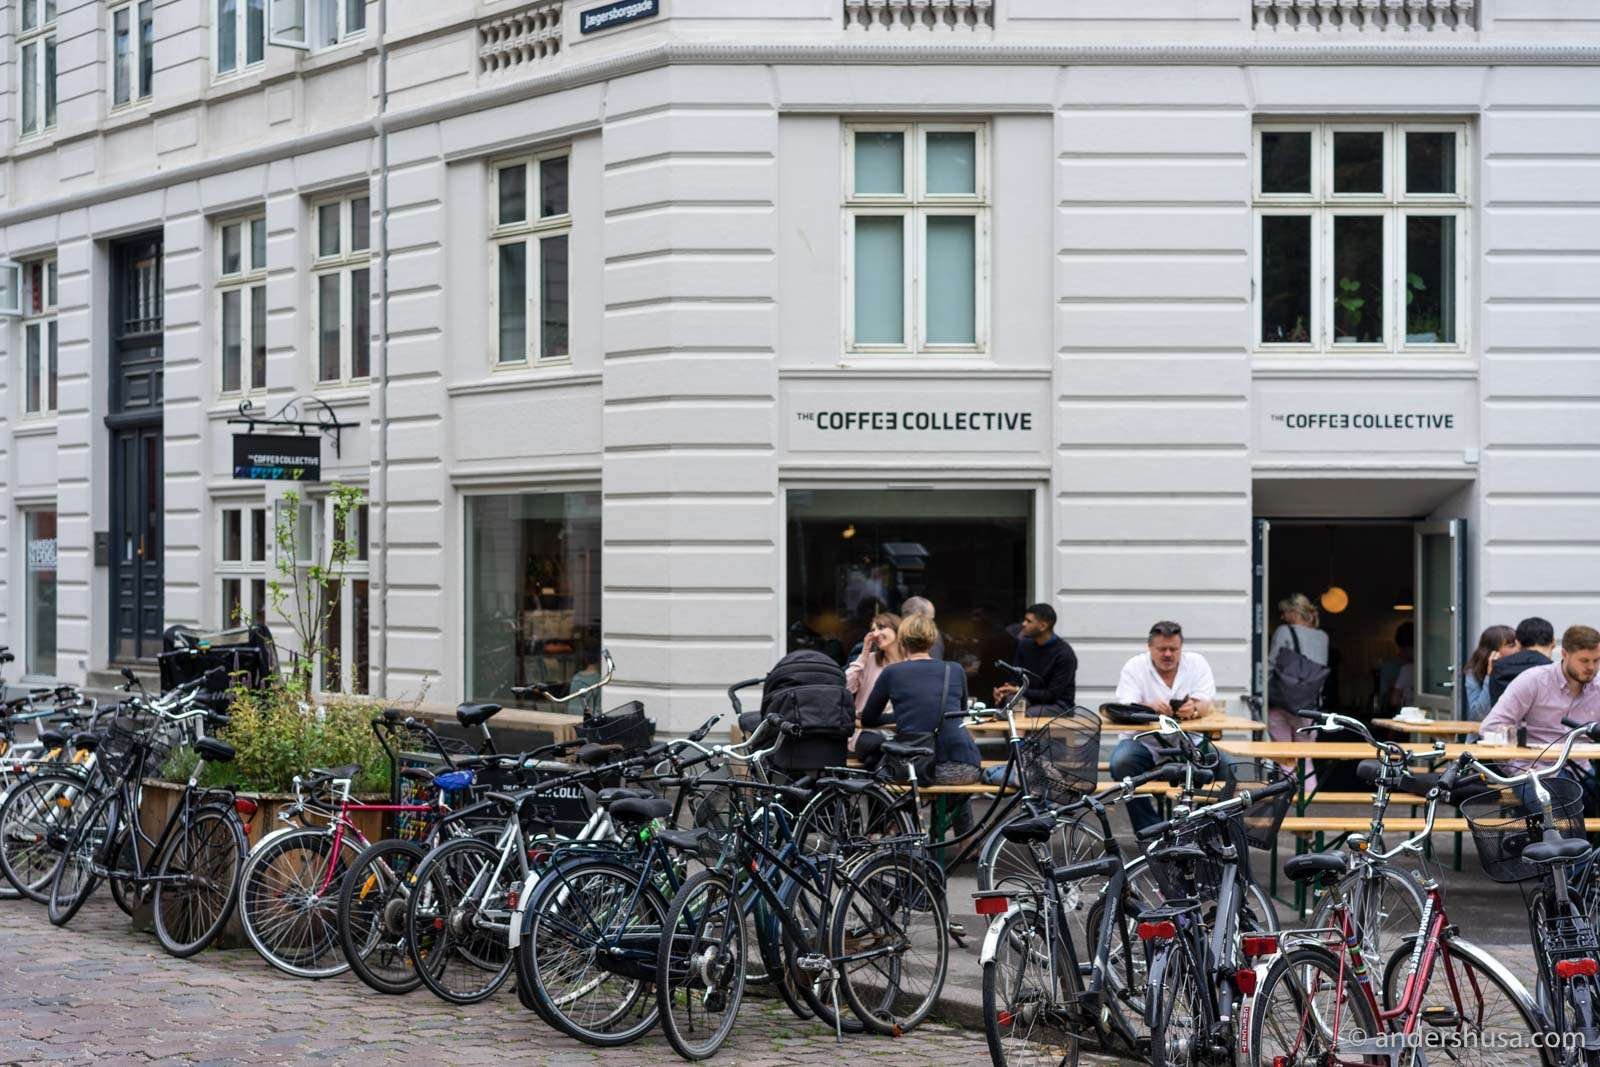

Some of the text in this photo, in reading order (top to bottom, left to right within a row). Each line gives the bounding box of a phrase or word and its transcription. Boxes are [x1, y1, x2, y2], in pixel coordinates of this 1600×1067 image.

[796, 411, 1032, 430] THE COFFEE COLLECTIVE
[1270, 413, 1454, 429] THE COFFEE COLLECTIVE
[280, 456, 319, 466] COLLECTIVE
[1241, 1007, 1249, 1052] CRESCENT
